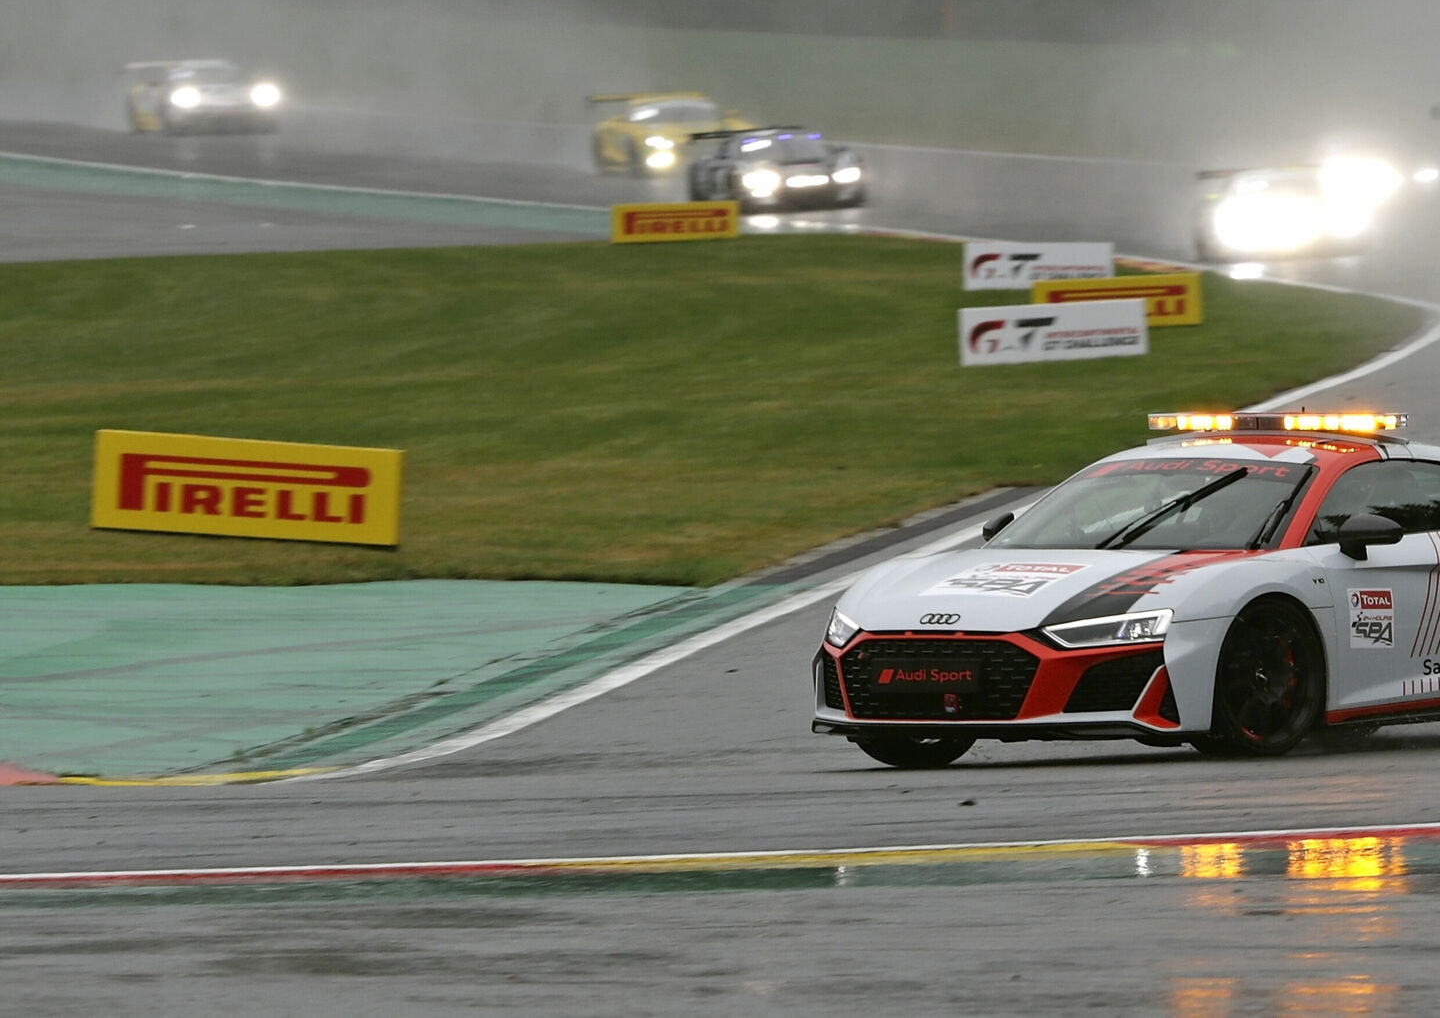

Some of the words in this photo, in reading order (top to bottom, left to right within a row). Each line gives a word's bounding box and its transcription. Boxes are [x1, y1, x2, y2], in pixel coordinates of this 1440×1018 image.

[1124, 459, 1196, 472] Audi
[116, 452, 373, 525] PIRELLI
[895, 668, 927, 681] Audi
[930, 668, 973, 683] Sport
